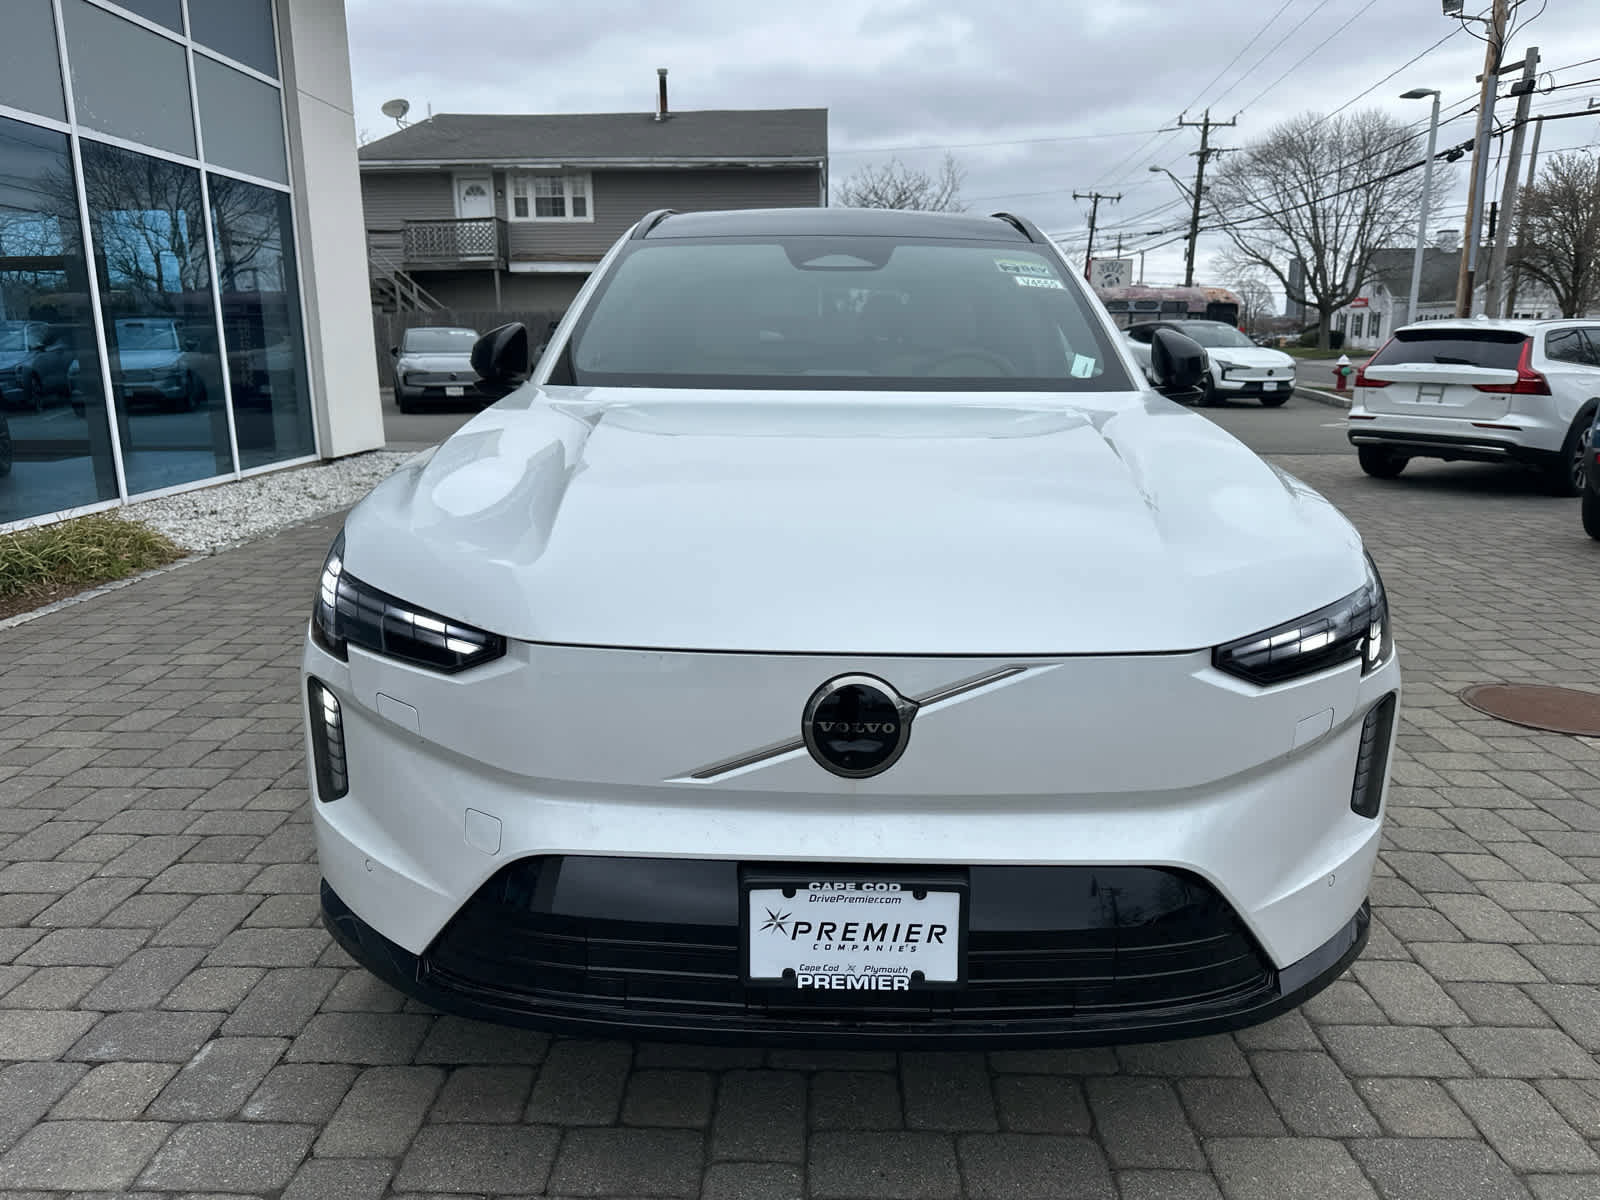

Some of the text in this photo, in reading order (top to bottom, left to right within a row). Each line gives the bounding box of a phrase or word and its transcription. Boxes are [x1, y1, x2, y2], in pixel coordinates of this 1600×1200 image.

[817, 722, 896, 734] VOLVO
[808, 882, 901, 892] CAPE COD
[809, 894, 902, 904] DrivePremier.com
[791, 921, 947, 944] PREMIER
[799, 964, 909, 974] Cape Cod Plymouth
[797, 974, 910, 991] PREMIER
